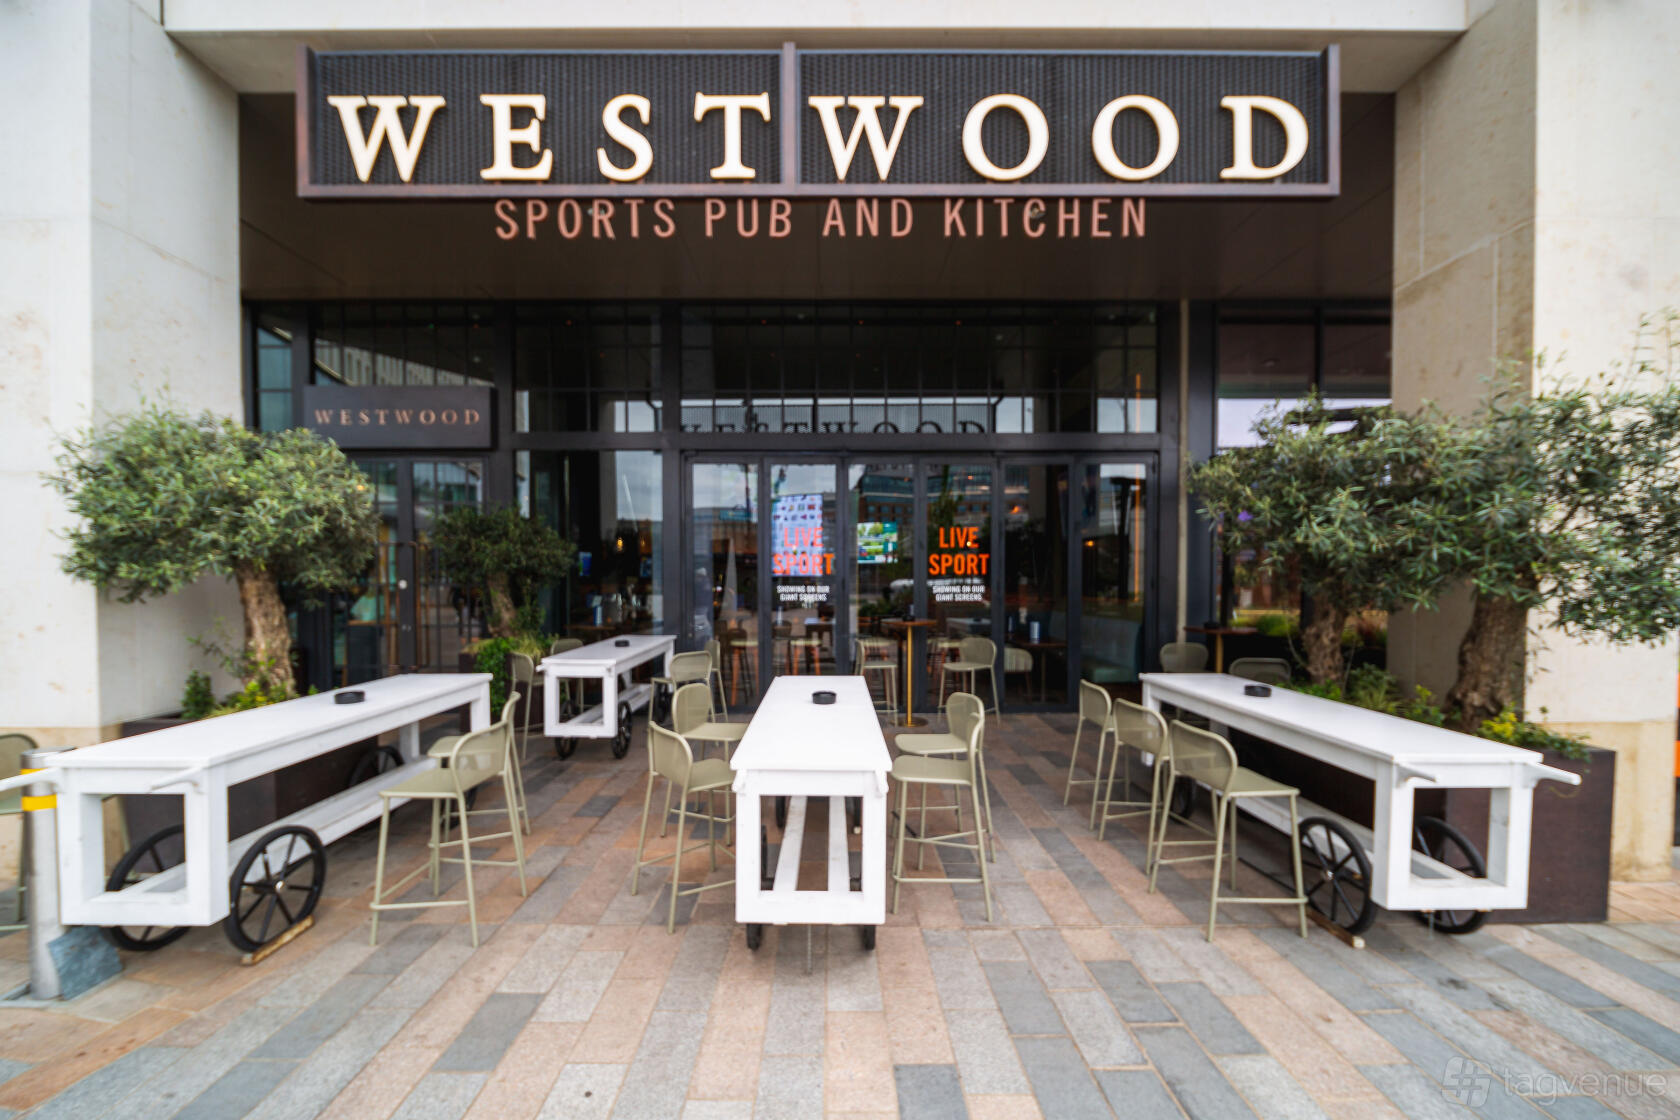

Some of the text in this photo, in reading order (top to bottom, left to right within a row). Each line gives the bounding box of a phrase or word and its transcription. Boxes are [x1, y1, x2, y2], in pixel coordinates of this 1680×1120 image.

[326, 92, 1310, 183] WESTWOOD
[494, 198, 1147, 240] SPORTS PUB AND KITCHEN
[314, 408, 480, 426] WESTWOOD
[783, 527, 824, 548] LIVE
[938, 526, 980, 549] LIVE
[772, 553, 836, 575] SPORT
[928, 553, 991, 576] SPORT
[776, 585, 806, 594] SHOWING
[806, 585, 816, 593] ON
[932, 585, 986, 594] SHOWING ON OUR
[935, 593, 983, 602] GIANT SCREENS
